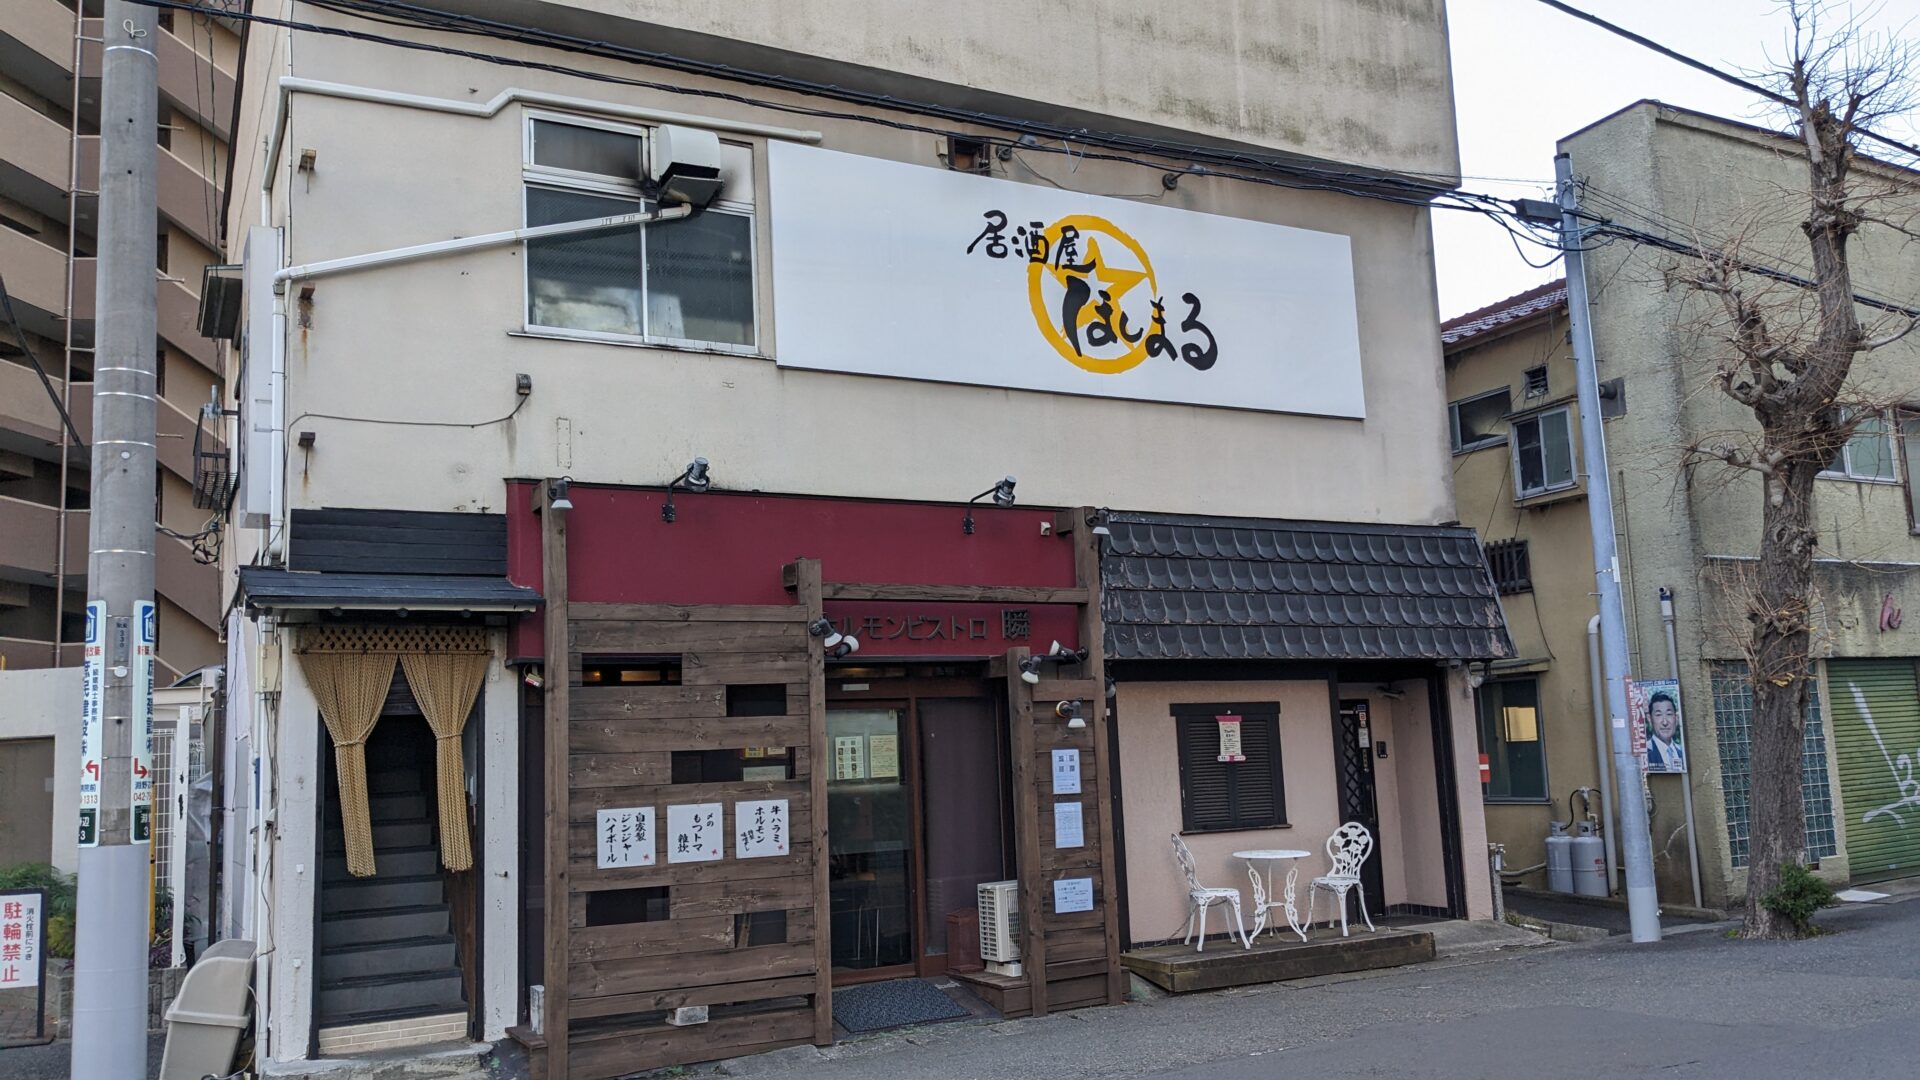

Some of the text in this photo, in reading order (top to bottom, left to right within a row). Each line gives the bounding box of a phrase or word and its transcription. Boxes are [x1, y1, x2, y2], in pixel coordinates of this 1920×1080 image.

[967, 210, 1096, 273] 居酒屋
[1062, 275, 1218, 371] ほしまる
[605, 817, 618, 863] ハイボール
[621, 813, 632, 862] ジンジャー
[635, 812, 647, 842] 自家製
[678, 833, 690, 853] 雑炊
[691, 813, 703, 852] もつトマ
[755, 806, 766, 844] ホルモン
[771, 805, 782, 843] 牛ハラミ
[1, 901, 23, 982] 駐輪禁止
[25, 907, 35, 961] 消火栓前につき
